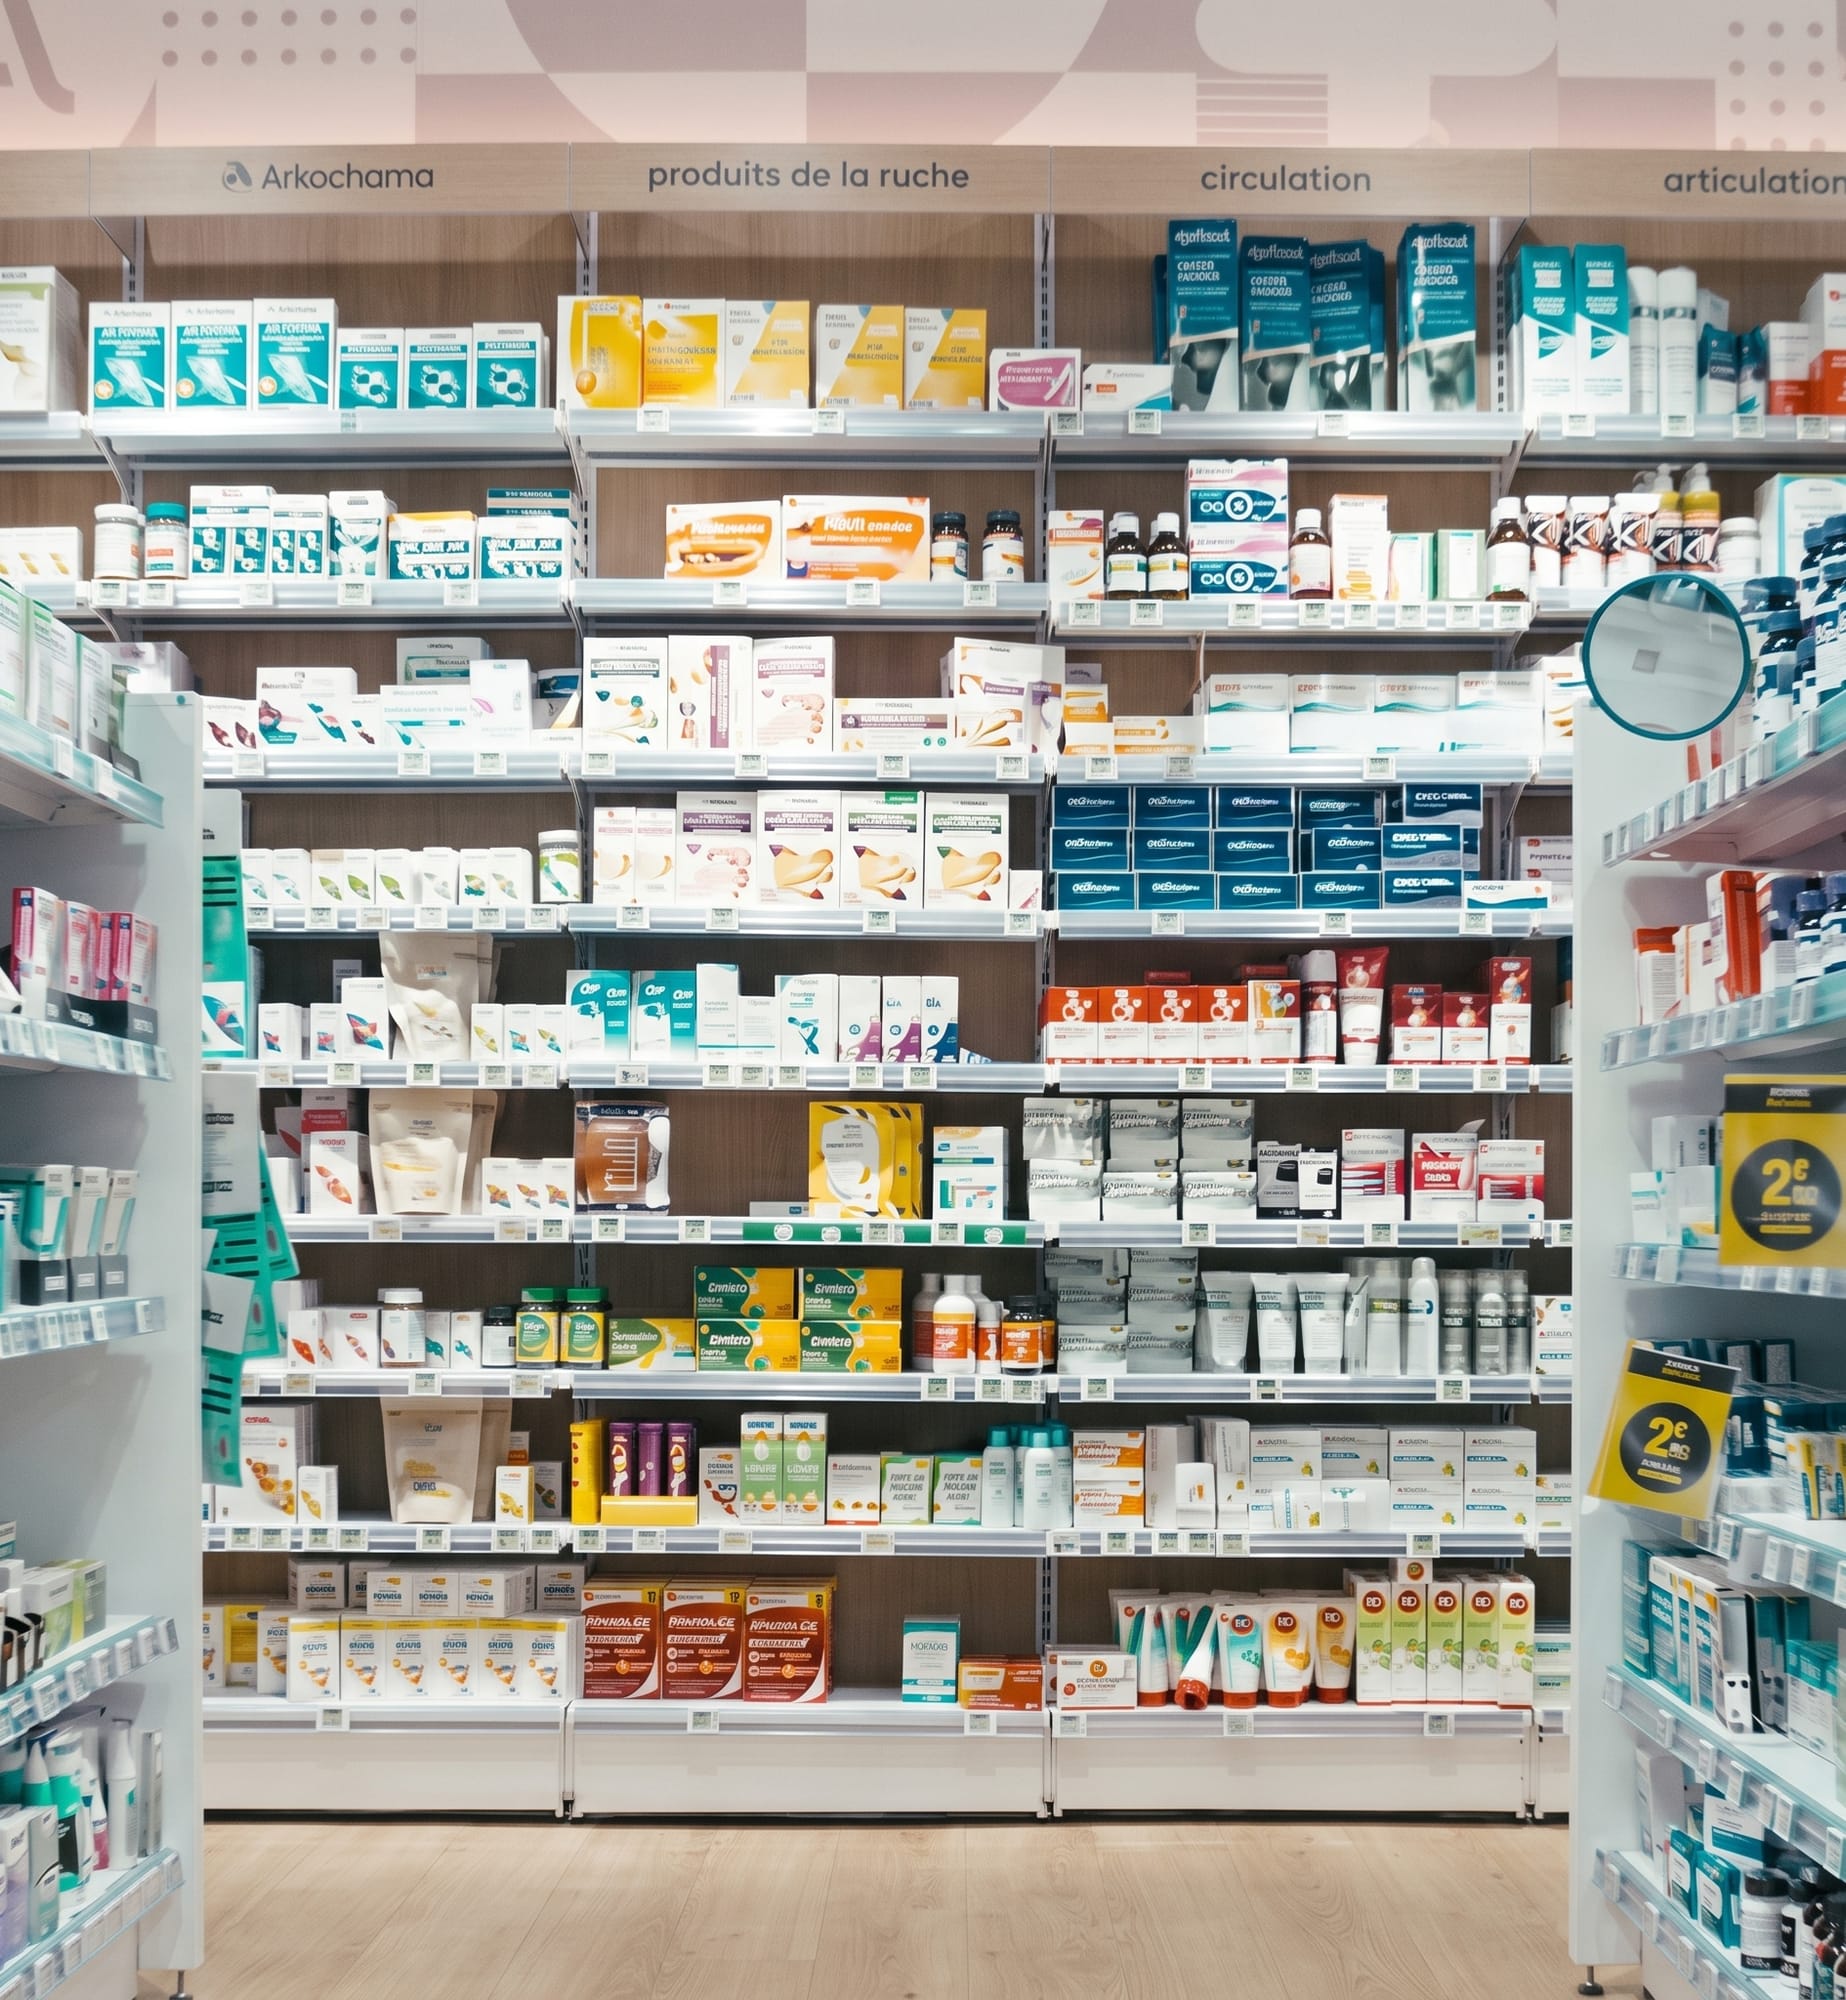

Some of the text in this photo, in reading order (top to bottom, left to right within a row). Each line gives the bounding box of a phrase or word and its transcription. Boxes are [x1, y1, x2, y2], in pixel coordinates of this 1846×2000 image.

[262, 162, 434, 189] Arkochama
[649, 161, 970, 193] produits de la ruche
[1200, 163, 1371, 191] circulation
[1663, 166, 1846, 195] articulation
